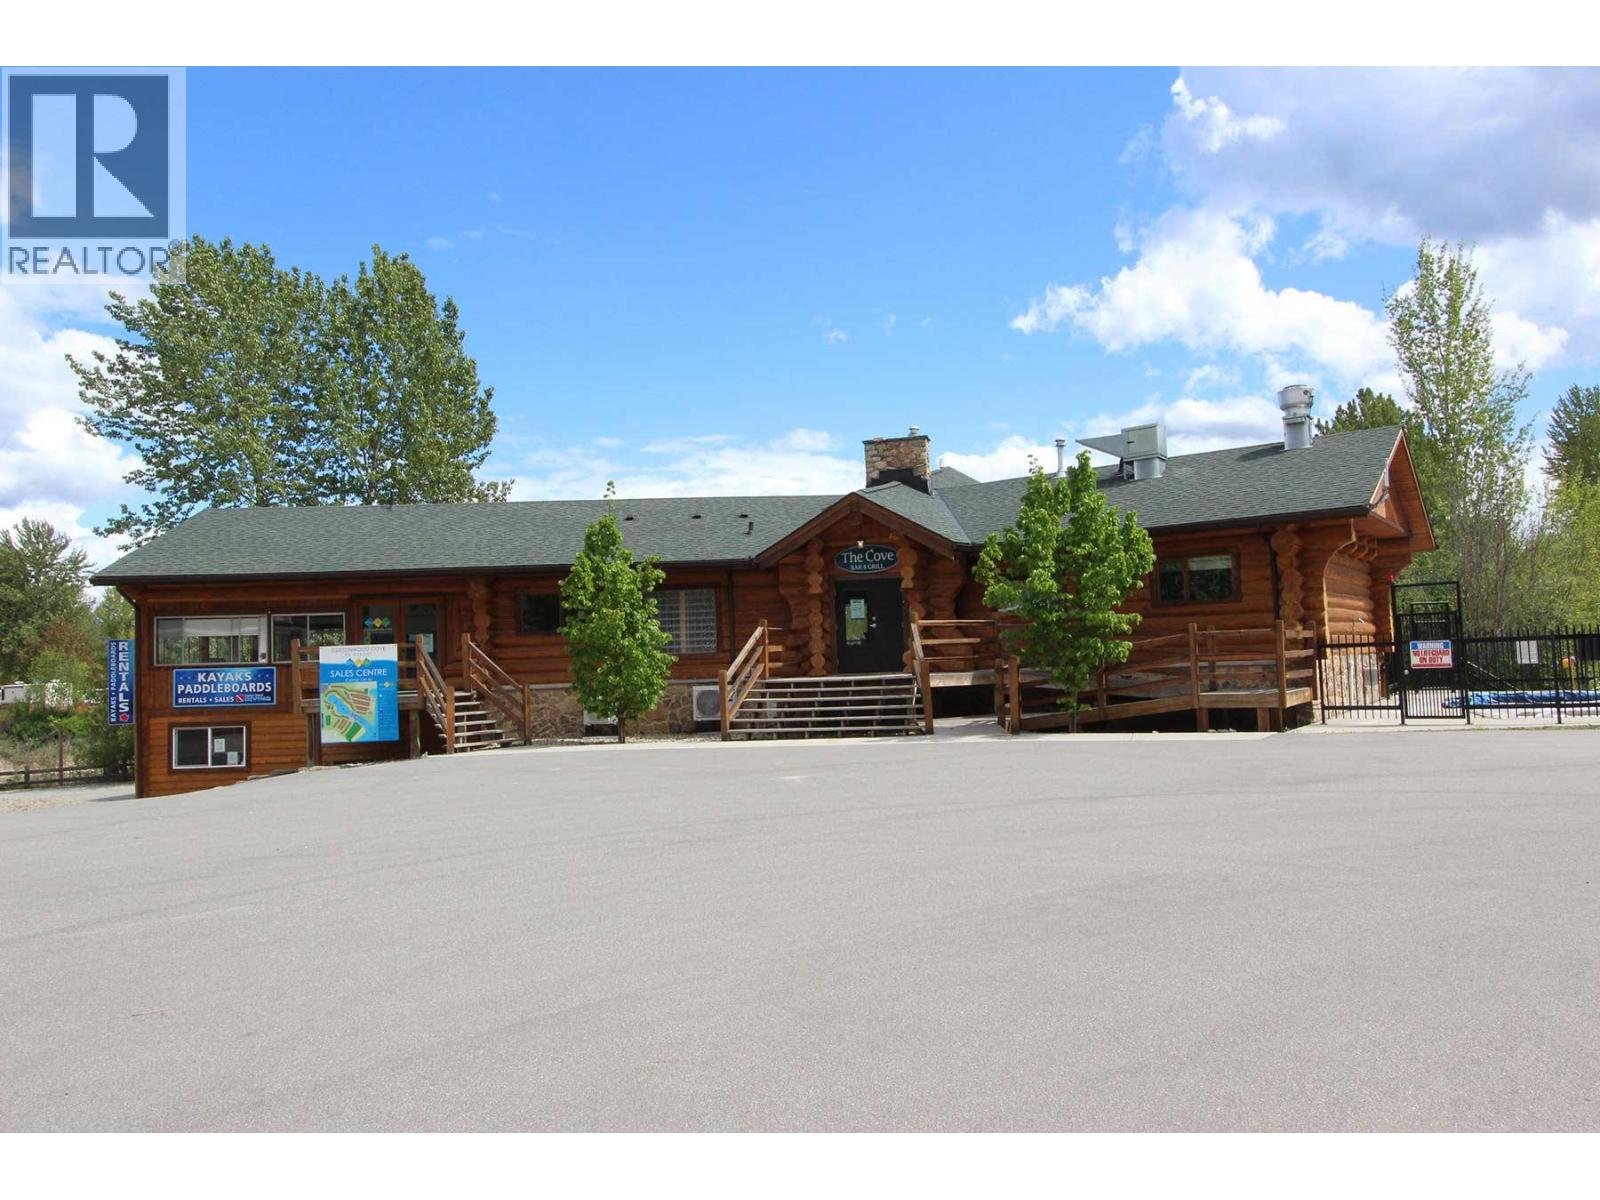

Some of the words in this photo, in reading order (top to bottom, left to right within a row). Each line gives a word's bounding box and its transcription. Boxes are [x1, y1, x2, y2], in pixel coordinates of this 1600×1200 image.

[841, 551, 864, 563] The
[865, 548, 895, 562] Cove
[118, 641, 129, 713] RENTALS
[197, 671, 252, 682] KAYAKS
[330, 669, 354, 678] SALES
[355, 668, 387, 677] CENTRE
[177, 682, 272, 694] PADDLEBOARDS
